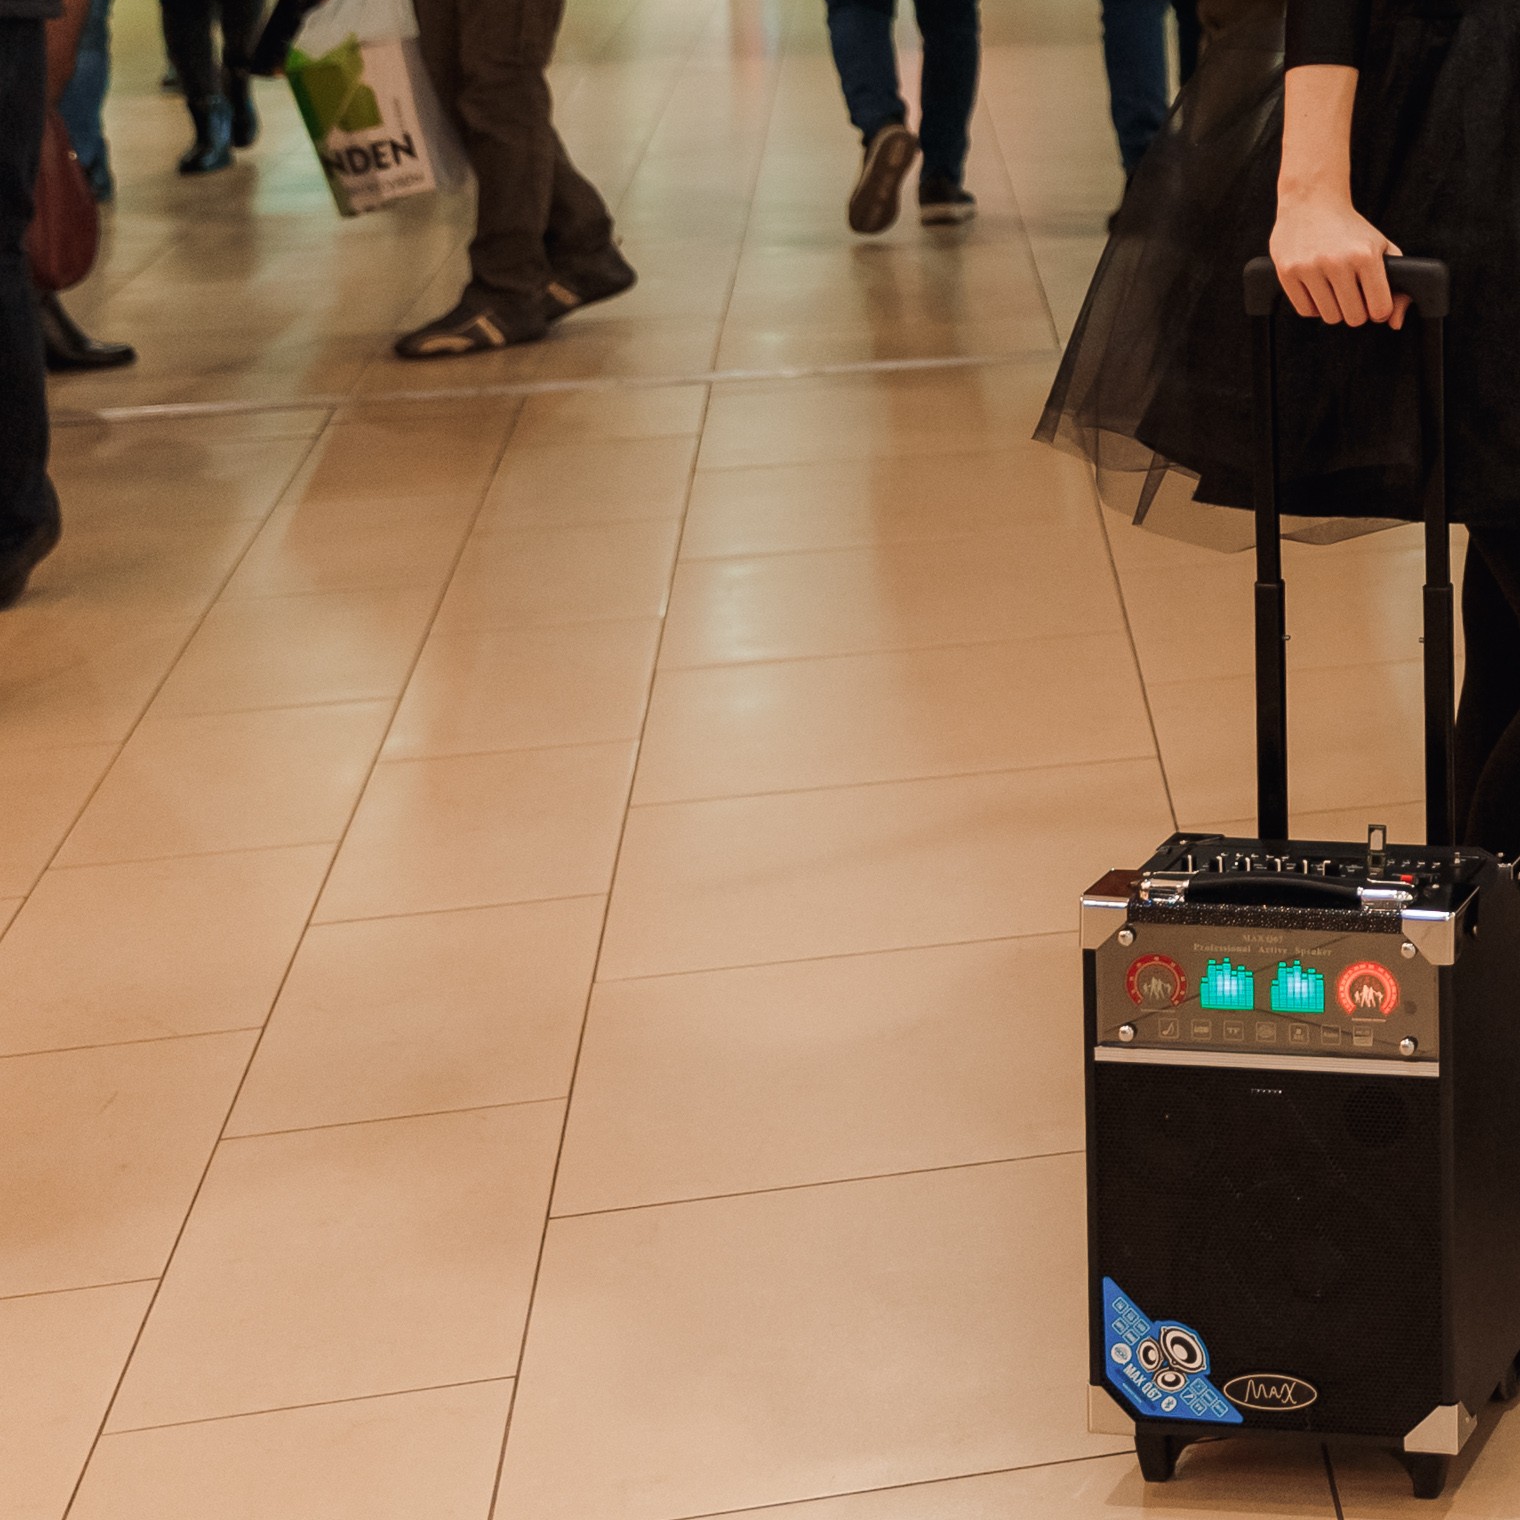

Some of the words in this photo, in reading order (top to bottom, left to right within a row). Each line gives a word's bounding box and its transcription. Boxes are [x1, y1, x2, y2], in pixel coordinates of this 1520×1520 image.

[1193, 943, 1251, 953] Professional
[1259, 945, 1288, 955] Active
[1294, 946, 1333, 957] Speaker
[1122, 1363, 1145, 1386] MAX
[1142, 1381, 1162, 1402] Q67
[1245, 1379, 1297, 1405] MAX
